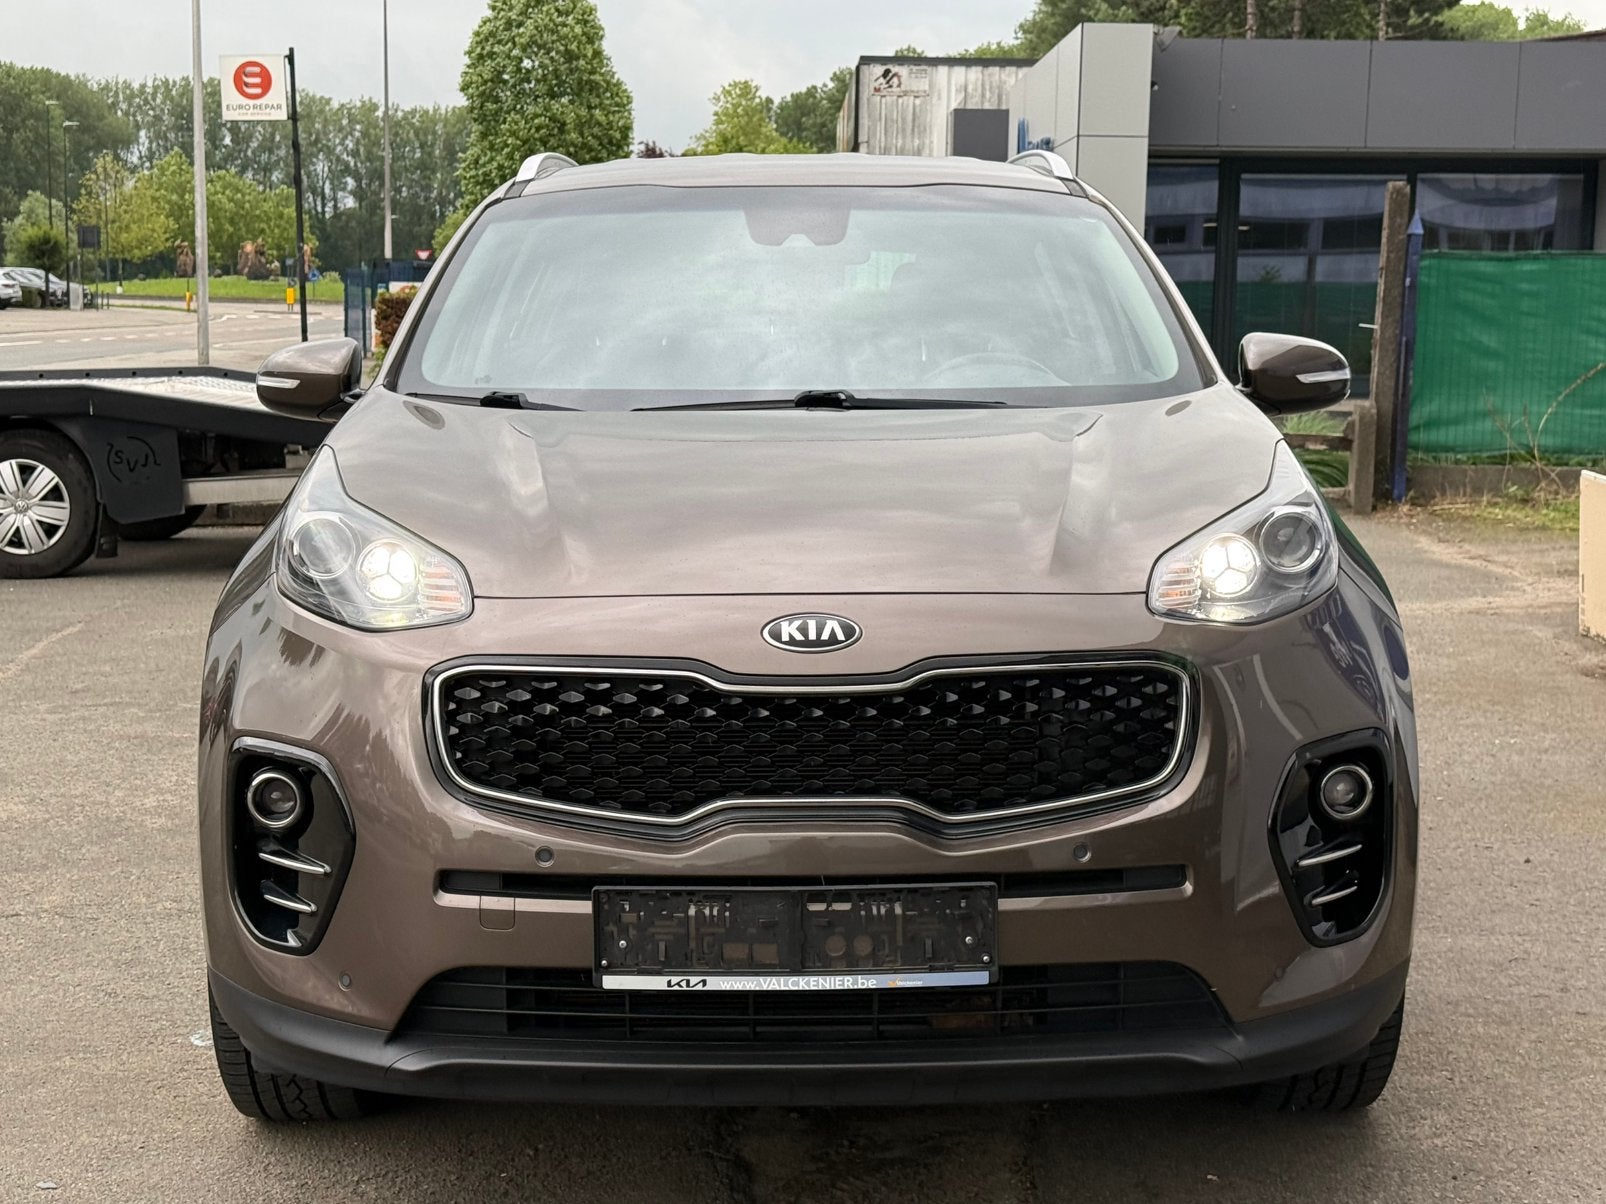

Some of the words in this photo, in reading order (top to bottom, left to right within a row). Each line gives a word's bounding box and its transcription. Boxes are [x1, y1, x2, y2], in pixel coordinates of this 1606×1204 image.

[225, 103, 251, 111] EURO
[252, 103, 282, 111] REPAR
[780, 619, 846, 641] KIA
[719, 976, 877, 990] www.VALCKENIER.be
